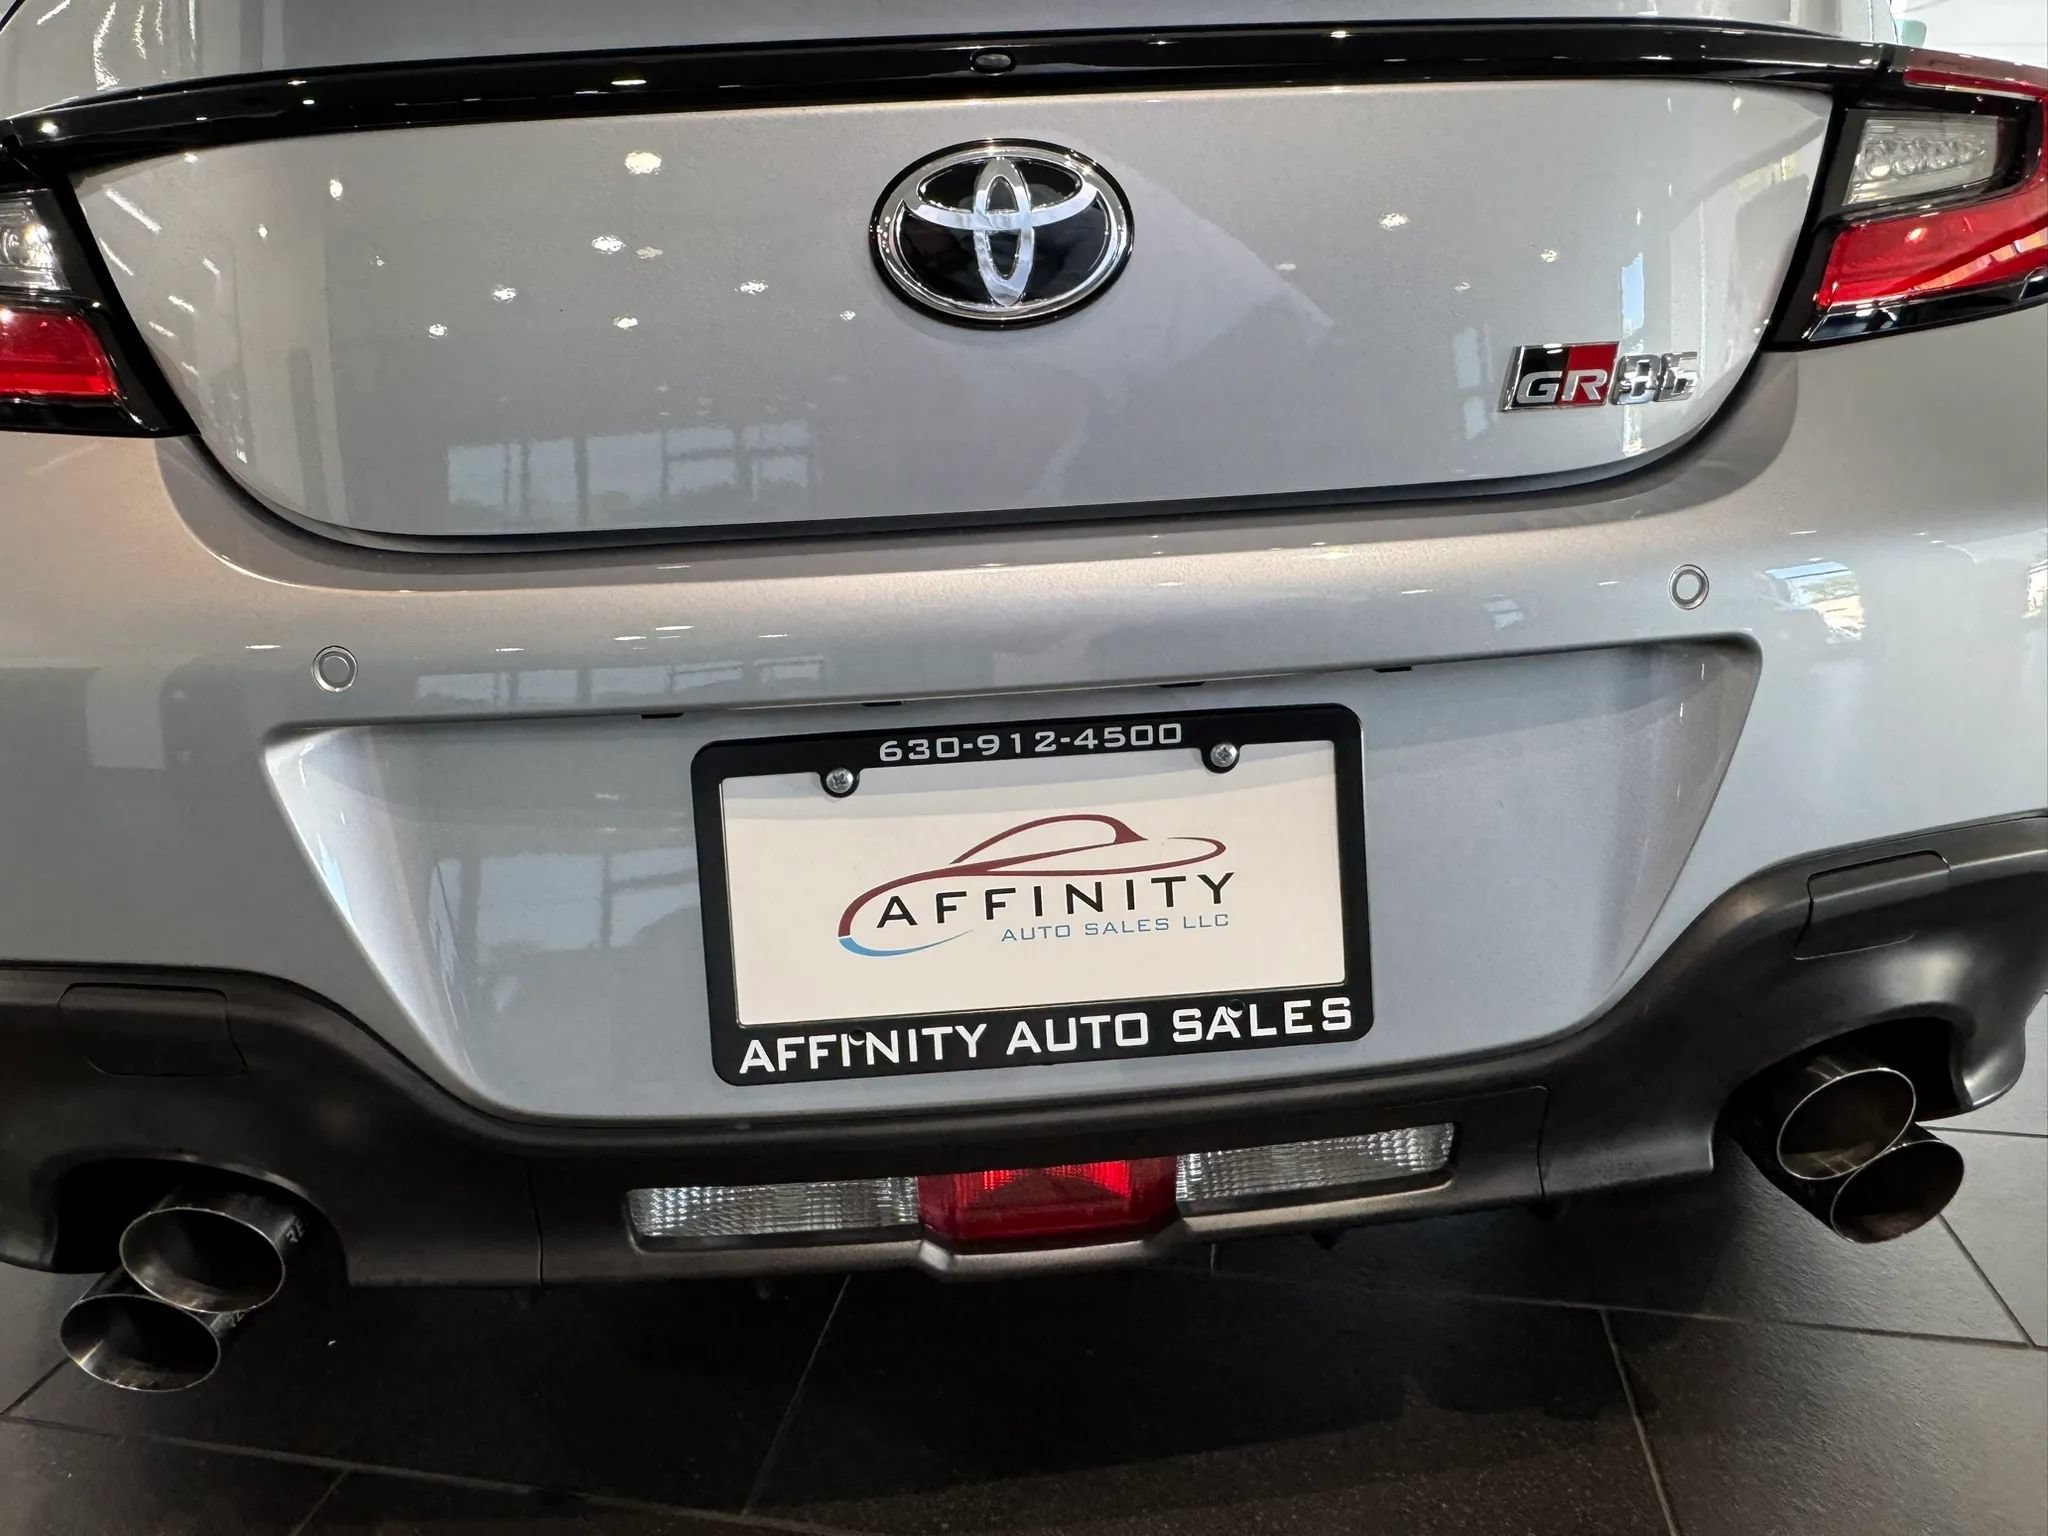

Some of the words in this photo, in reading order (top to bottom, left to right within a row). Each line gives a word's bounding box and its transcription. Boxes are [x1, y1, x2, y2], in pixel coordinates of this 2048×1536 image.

[879, 723, 1183, 762] 630-912-4500
[876, 872, 1235, 929] AFFINITY
[1001, 923, 1072, 942] AUTO
[1084, 917, 1171, 936] SALES
[1183, 913, 1230, 930] LLC
[738, 1024, 987, 1074] AFFINITY
[1005, 1012, 1149, 1055] AUTO
[1173, 996, 1352, 1043] SALES
